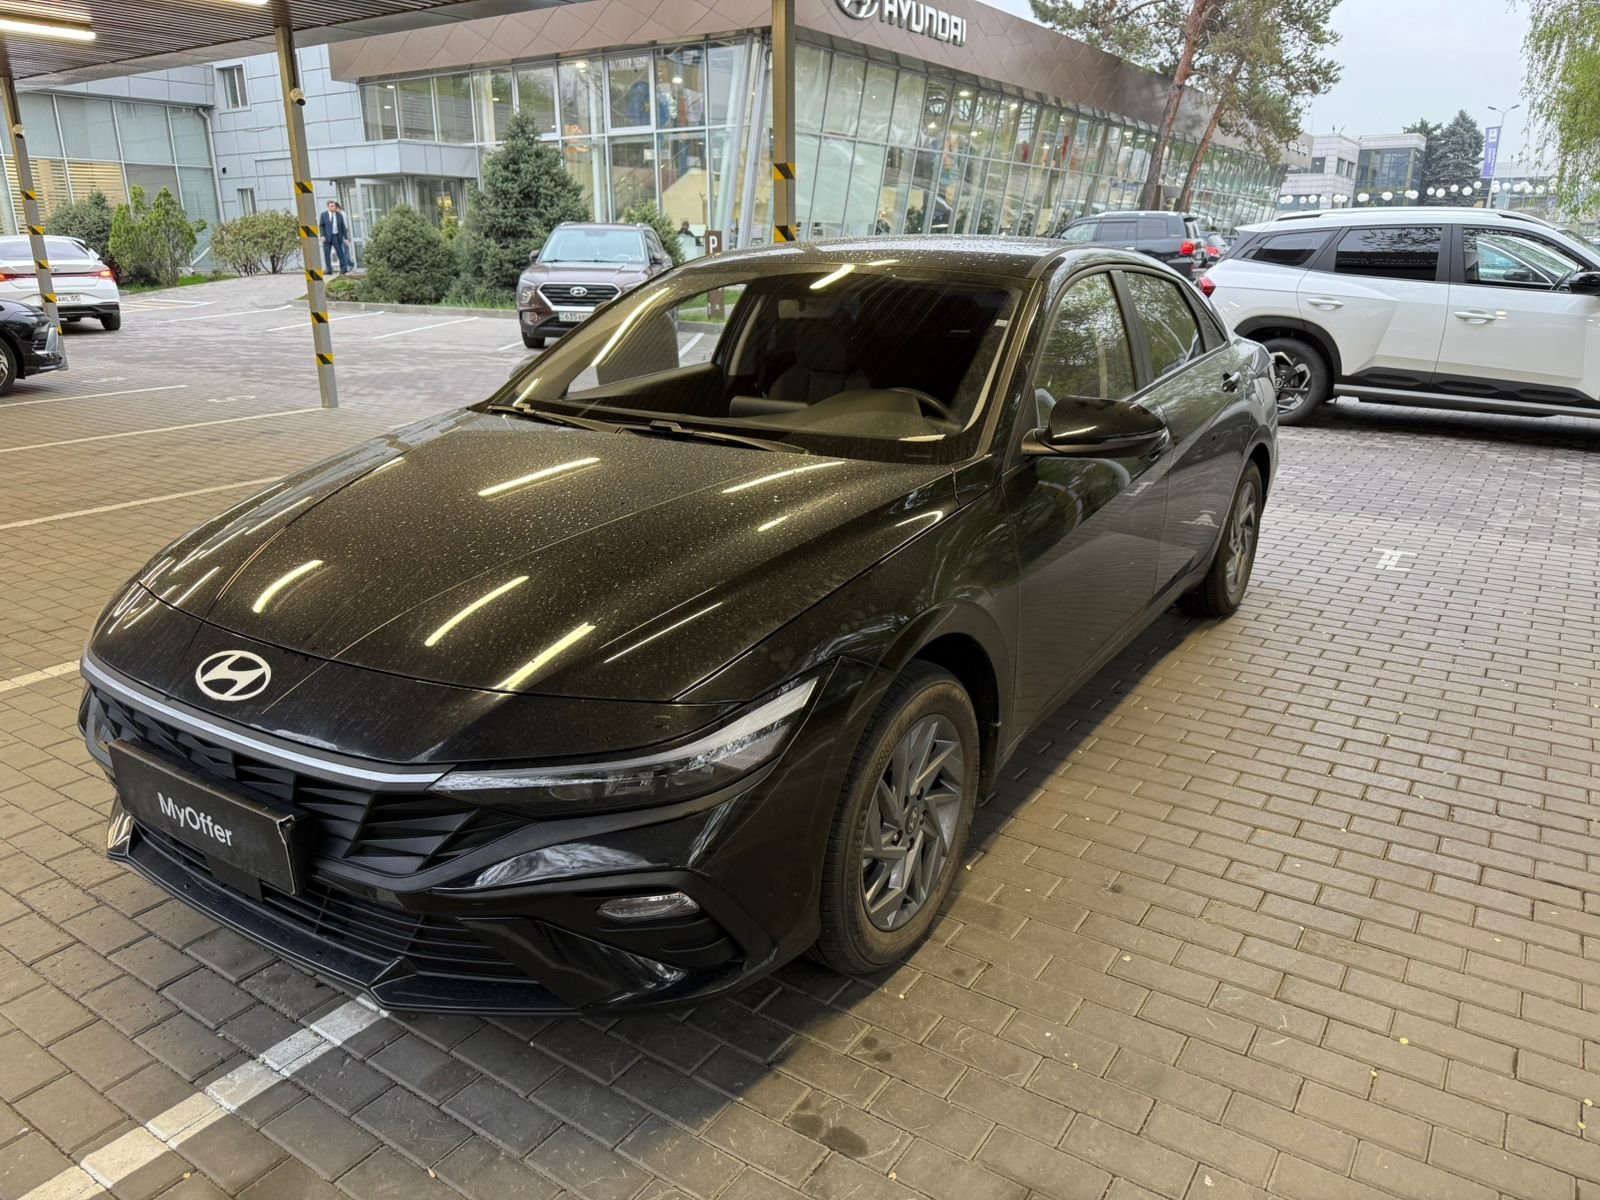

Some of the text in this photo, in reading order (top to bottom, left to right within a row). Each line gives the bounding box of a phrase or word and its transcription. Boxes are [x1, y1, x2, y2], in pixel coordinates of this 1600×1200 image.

[881, 0, 967, 46] HYUNDAI
[709, 235, 718, 254] P
[157, 791, 232, 847] MyOffer
